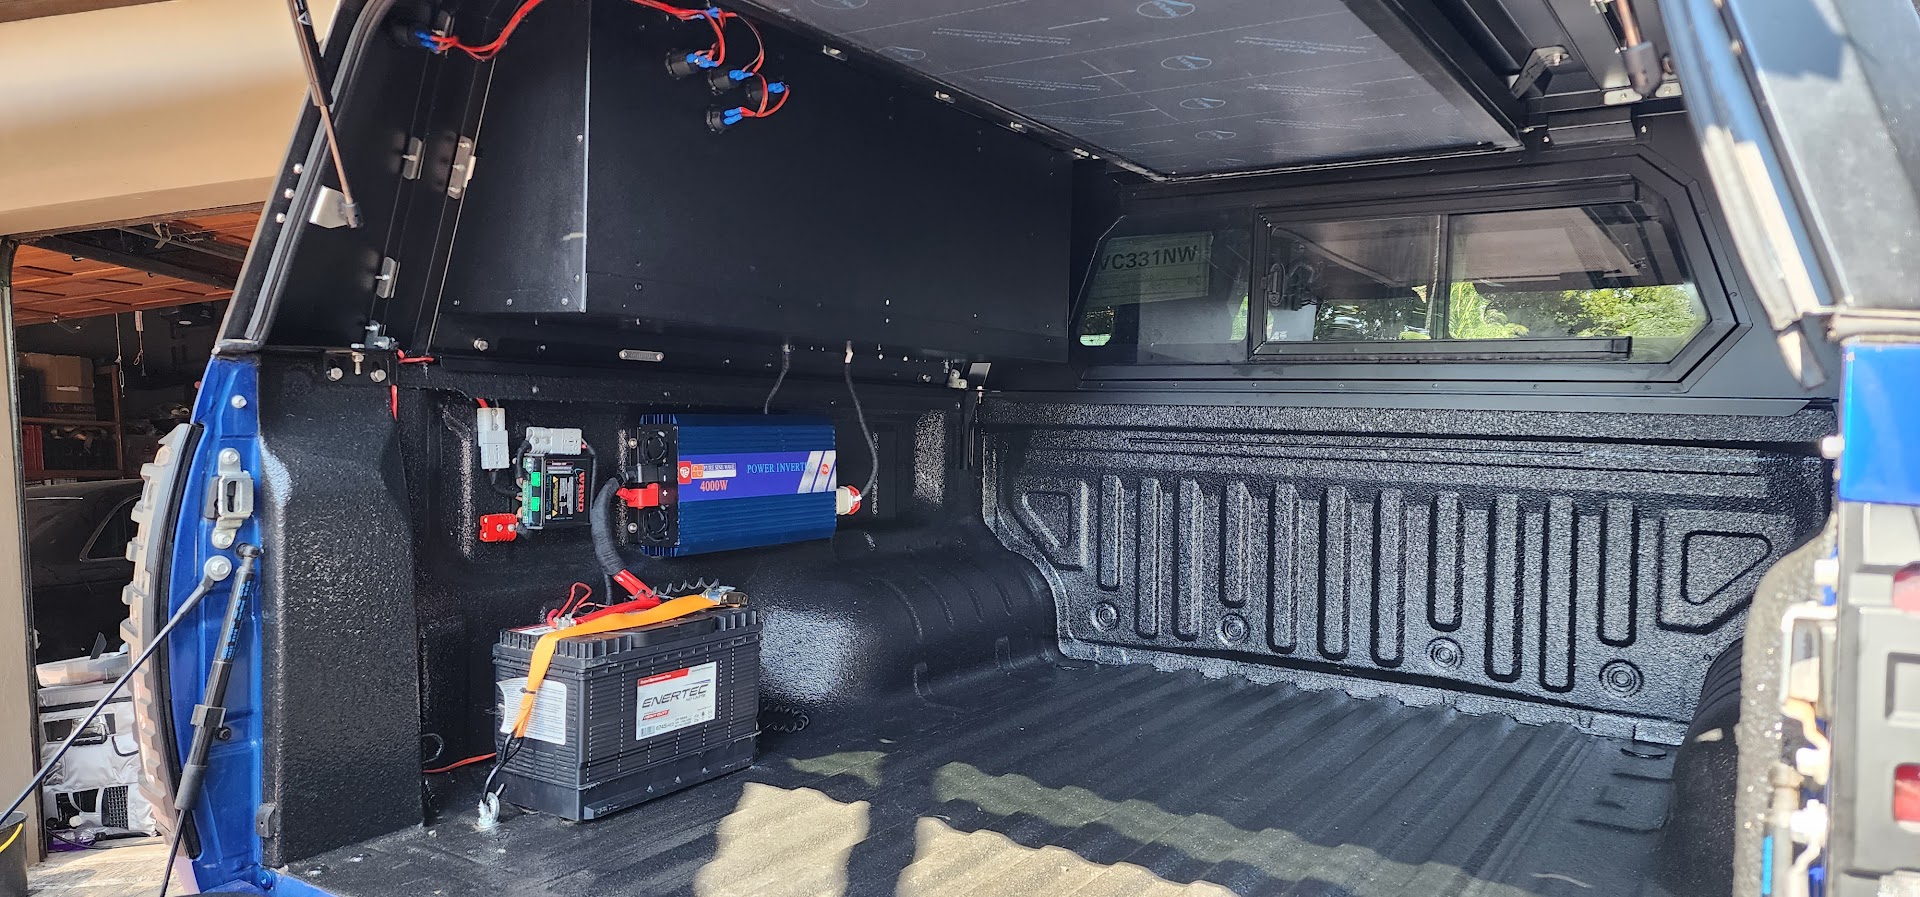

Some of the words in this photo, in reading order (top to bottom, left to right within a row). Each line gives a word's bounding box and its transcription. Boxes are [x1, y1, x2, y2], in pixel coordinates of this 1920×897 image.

[747, 463, 775, 474] POWER
[700, 480, 728, 491] 4000W
[642, 684, 708, 708] ENERTEC
